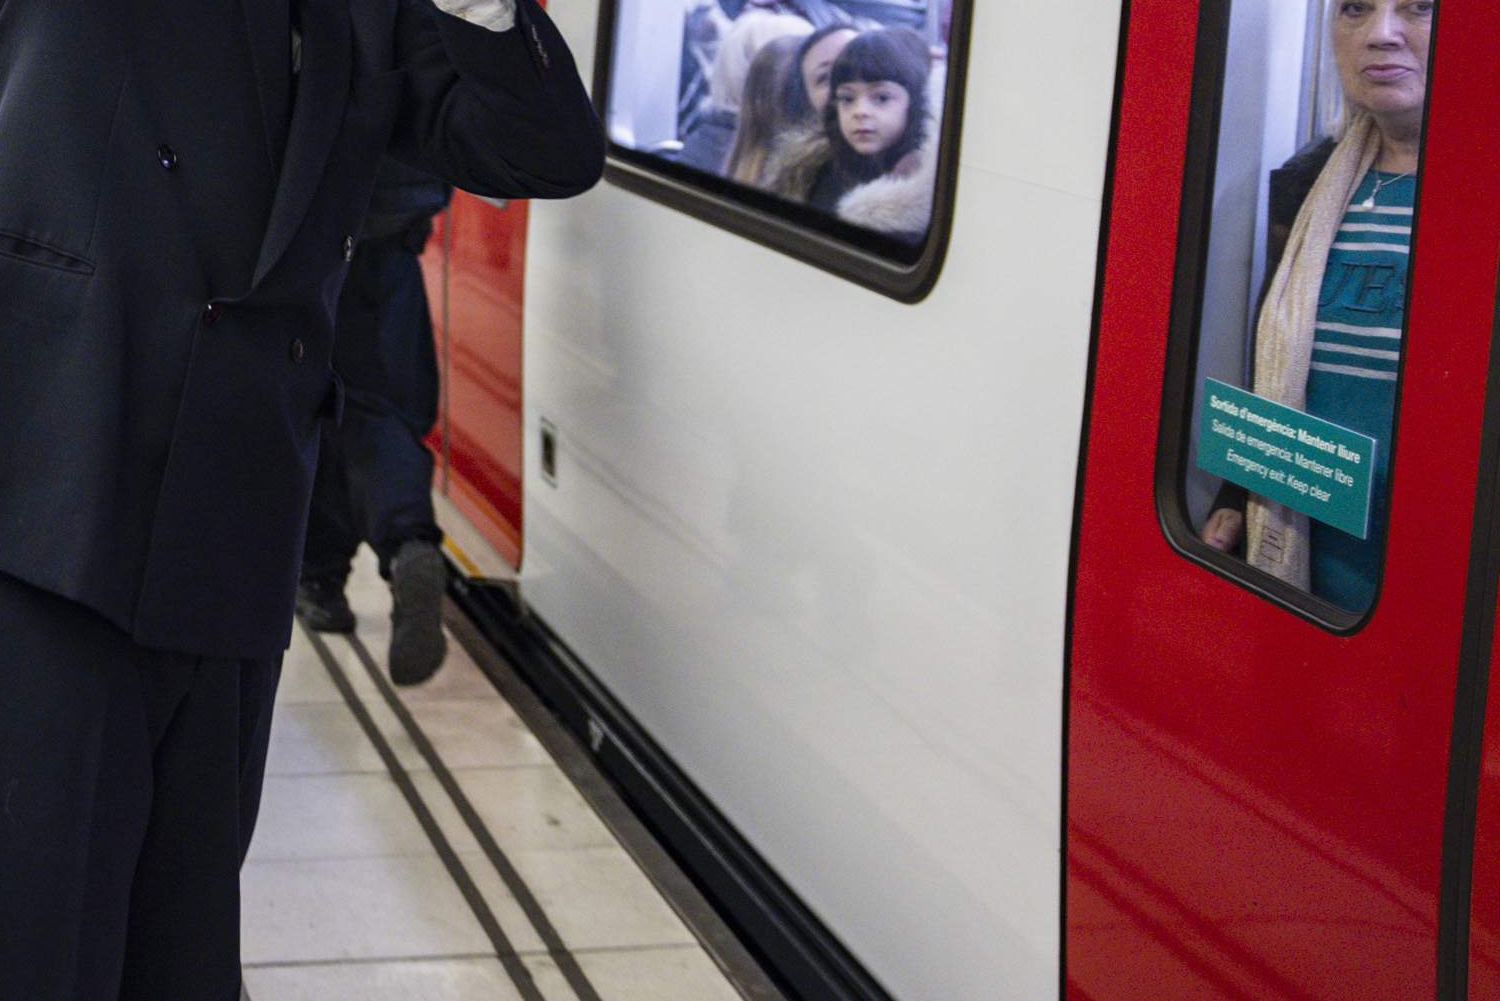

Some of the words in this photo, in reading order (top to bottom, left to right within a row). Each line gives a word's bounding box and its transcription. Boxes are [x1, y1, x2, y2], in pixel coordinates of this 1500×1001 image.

[1210, 394, 1239, 417] Sortida
[1296, 428, 1337, 455] Mantenir
[1337, 443, 1361, 465] lliure
[1211, 418, 1235, 439] Salida
[1235, 430, 1247, 444] de
[1247, 435, 1294, 463] emergencia:
[1294, 452, 1334, 479] Mantener
[1334, 468, 1354, 487] libre
[1226, 448, 1270, 480] Emergency
[1286, 474, 1309, 496] Keep
[1309, 484, 1332, 502] clear
